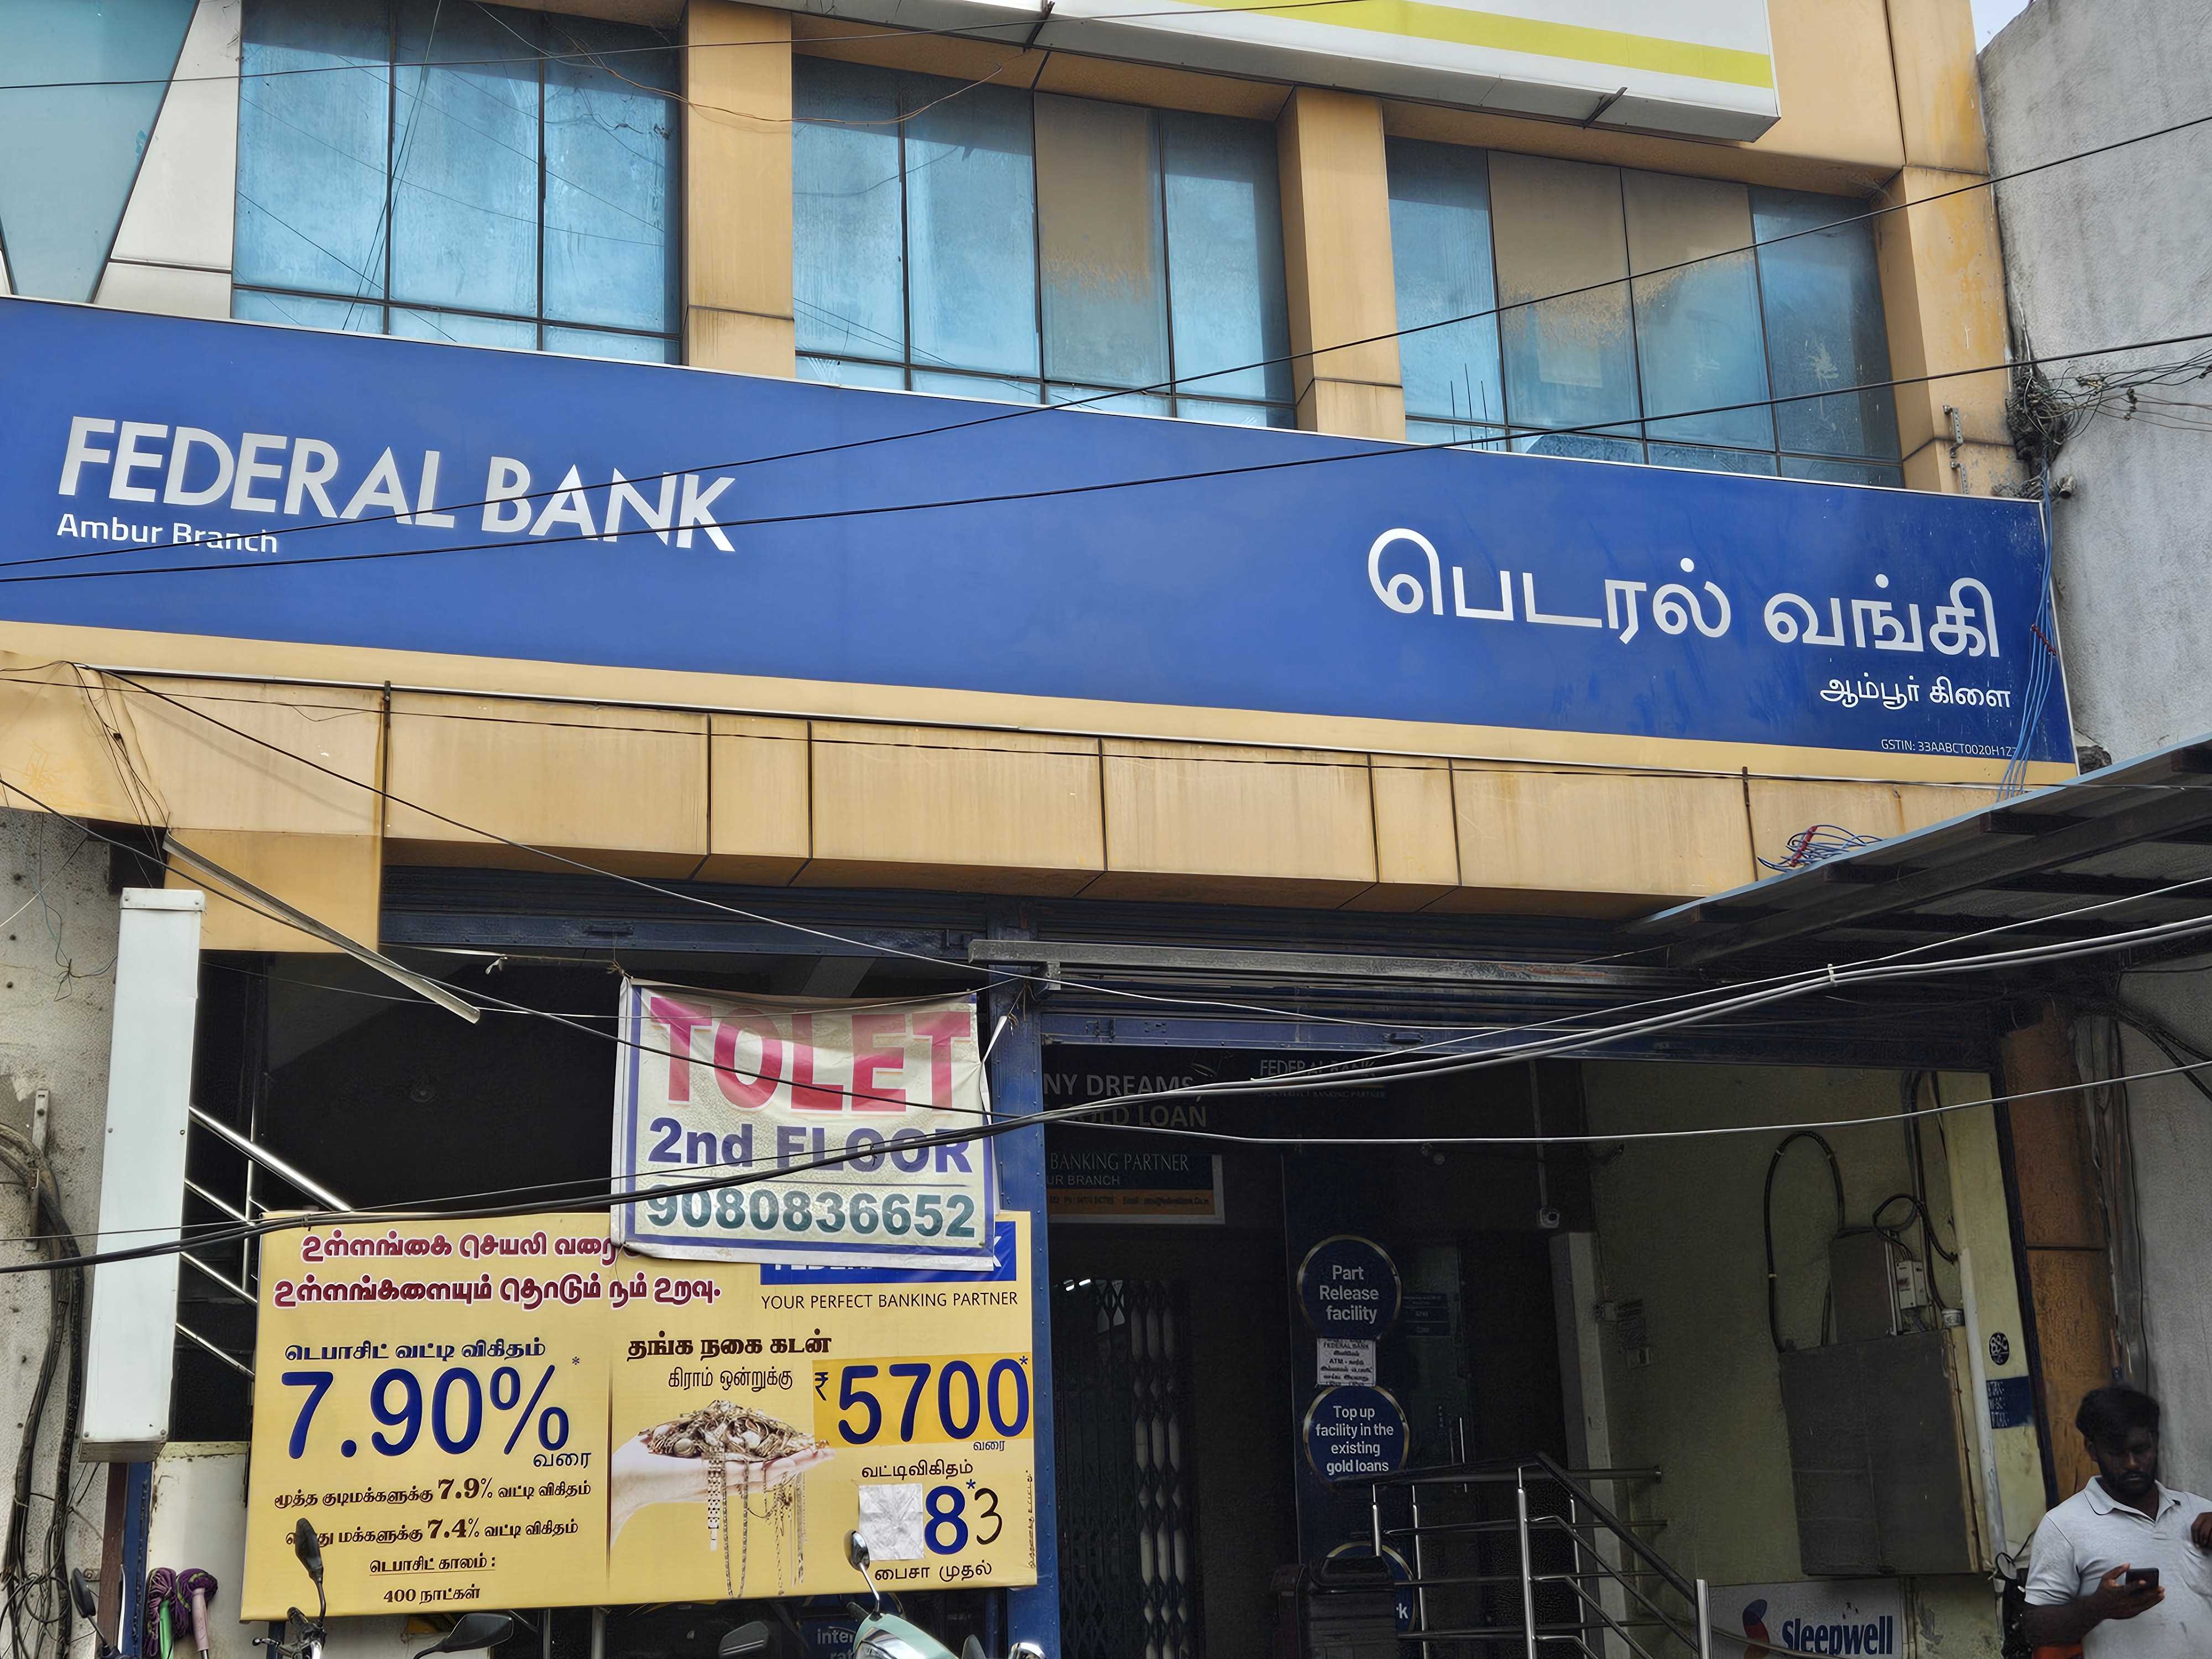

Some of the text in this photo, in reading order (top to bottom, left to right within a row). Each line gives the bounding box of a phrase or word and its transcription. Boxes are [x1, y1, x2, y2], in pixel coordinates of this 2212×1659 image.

[58, 416, 736, 552] FEDERAL BANK
[56, 513, 278, 554] Ambur Branch
[1368, 527, 2000, 658] பெடரல் வங்கி
[1819, 672, 2011, 710] ஆம்பூர் கிளை
[1881, 739, 1916, 751] GSTIN:
[1043, 1073, 1078, 1096] NY
[648, 1117, 973, 1174] 2nd FLOOR
[1051, 1153, 1190, 1171] BANKING PARTNER
[1067, 1176, 1120, 1186] BRANCH
[646, 1183, 975, 1238] 9080836652
[302, 1229, 452, 1262] உள்ளங்கை
[459, 1231, 547, 1259] செயலி
[1332, 1264, 1365, 1281] Part
[499, 1272, 601, 1310] தொடும்
[609, 1272, 647, 1308] நம்
[761, 1291, 1018, 1309] YOUR PERFECT BANKING PARTNER
[1319, 1285, 1380, 1301] Release
[1325, 1305, 1378, 1325] facility
[285, 1337, 546, 1361] டெபாசிட் வட்டி விகிதம்
[626, 1328, 832, 1362] தங்க நகை கடன்
[668, 1365, 793, 1392] கிராம் ஒன்றுக்கு
[281, 1364, 570, 1459] 7.90%
[1332, 1405, 1376, 1421] Top up
[1315, 1422, 1394, 1439] facility in the
[973, 1440, 1005, 1451] வரை
[1331, 1441, 1381, 1457] existing
[533, 1452, 592, 1469] வரை
[861, 1458, 973, 1481] வட்டிவிகிதம்
[1326, 1459, 1390, 1476] gold loans
[274, 1489, 319, 1509] மூத்த
[437, 1477, 493, 1500] 7.9%
[498, 1485, 535, 1500] வட்டி
[538, 1480, 591, 1499] விகிதம்
[338, 1525, 423, 1544] மக்களுக்கு
[427, 1517, 479, 1539] 7.4%
[484, 1524, 521, 1538] வட்டி
[525, 1519, 578, 1537] விகிதம்
[369, 1555, 435, 1573] டெபாசிட்
[439, 1552, 487, 1569] காலம்
[874, 1559, 992, 1582] பைசா முதல்
[383, 1583, 481, 1605] 400 நாட்கள்
